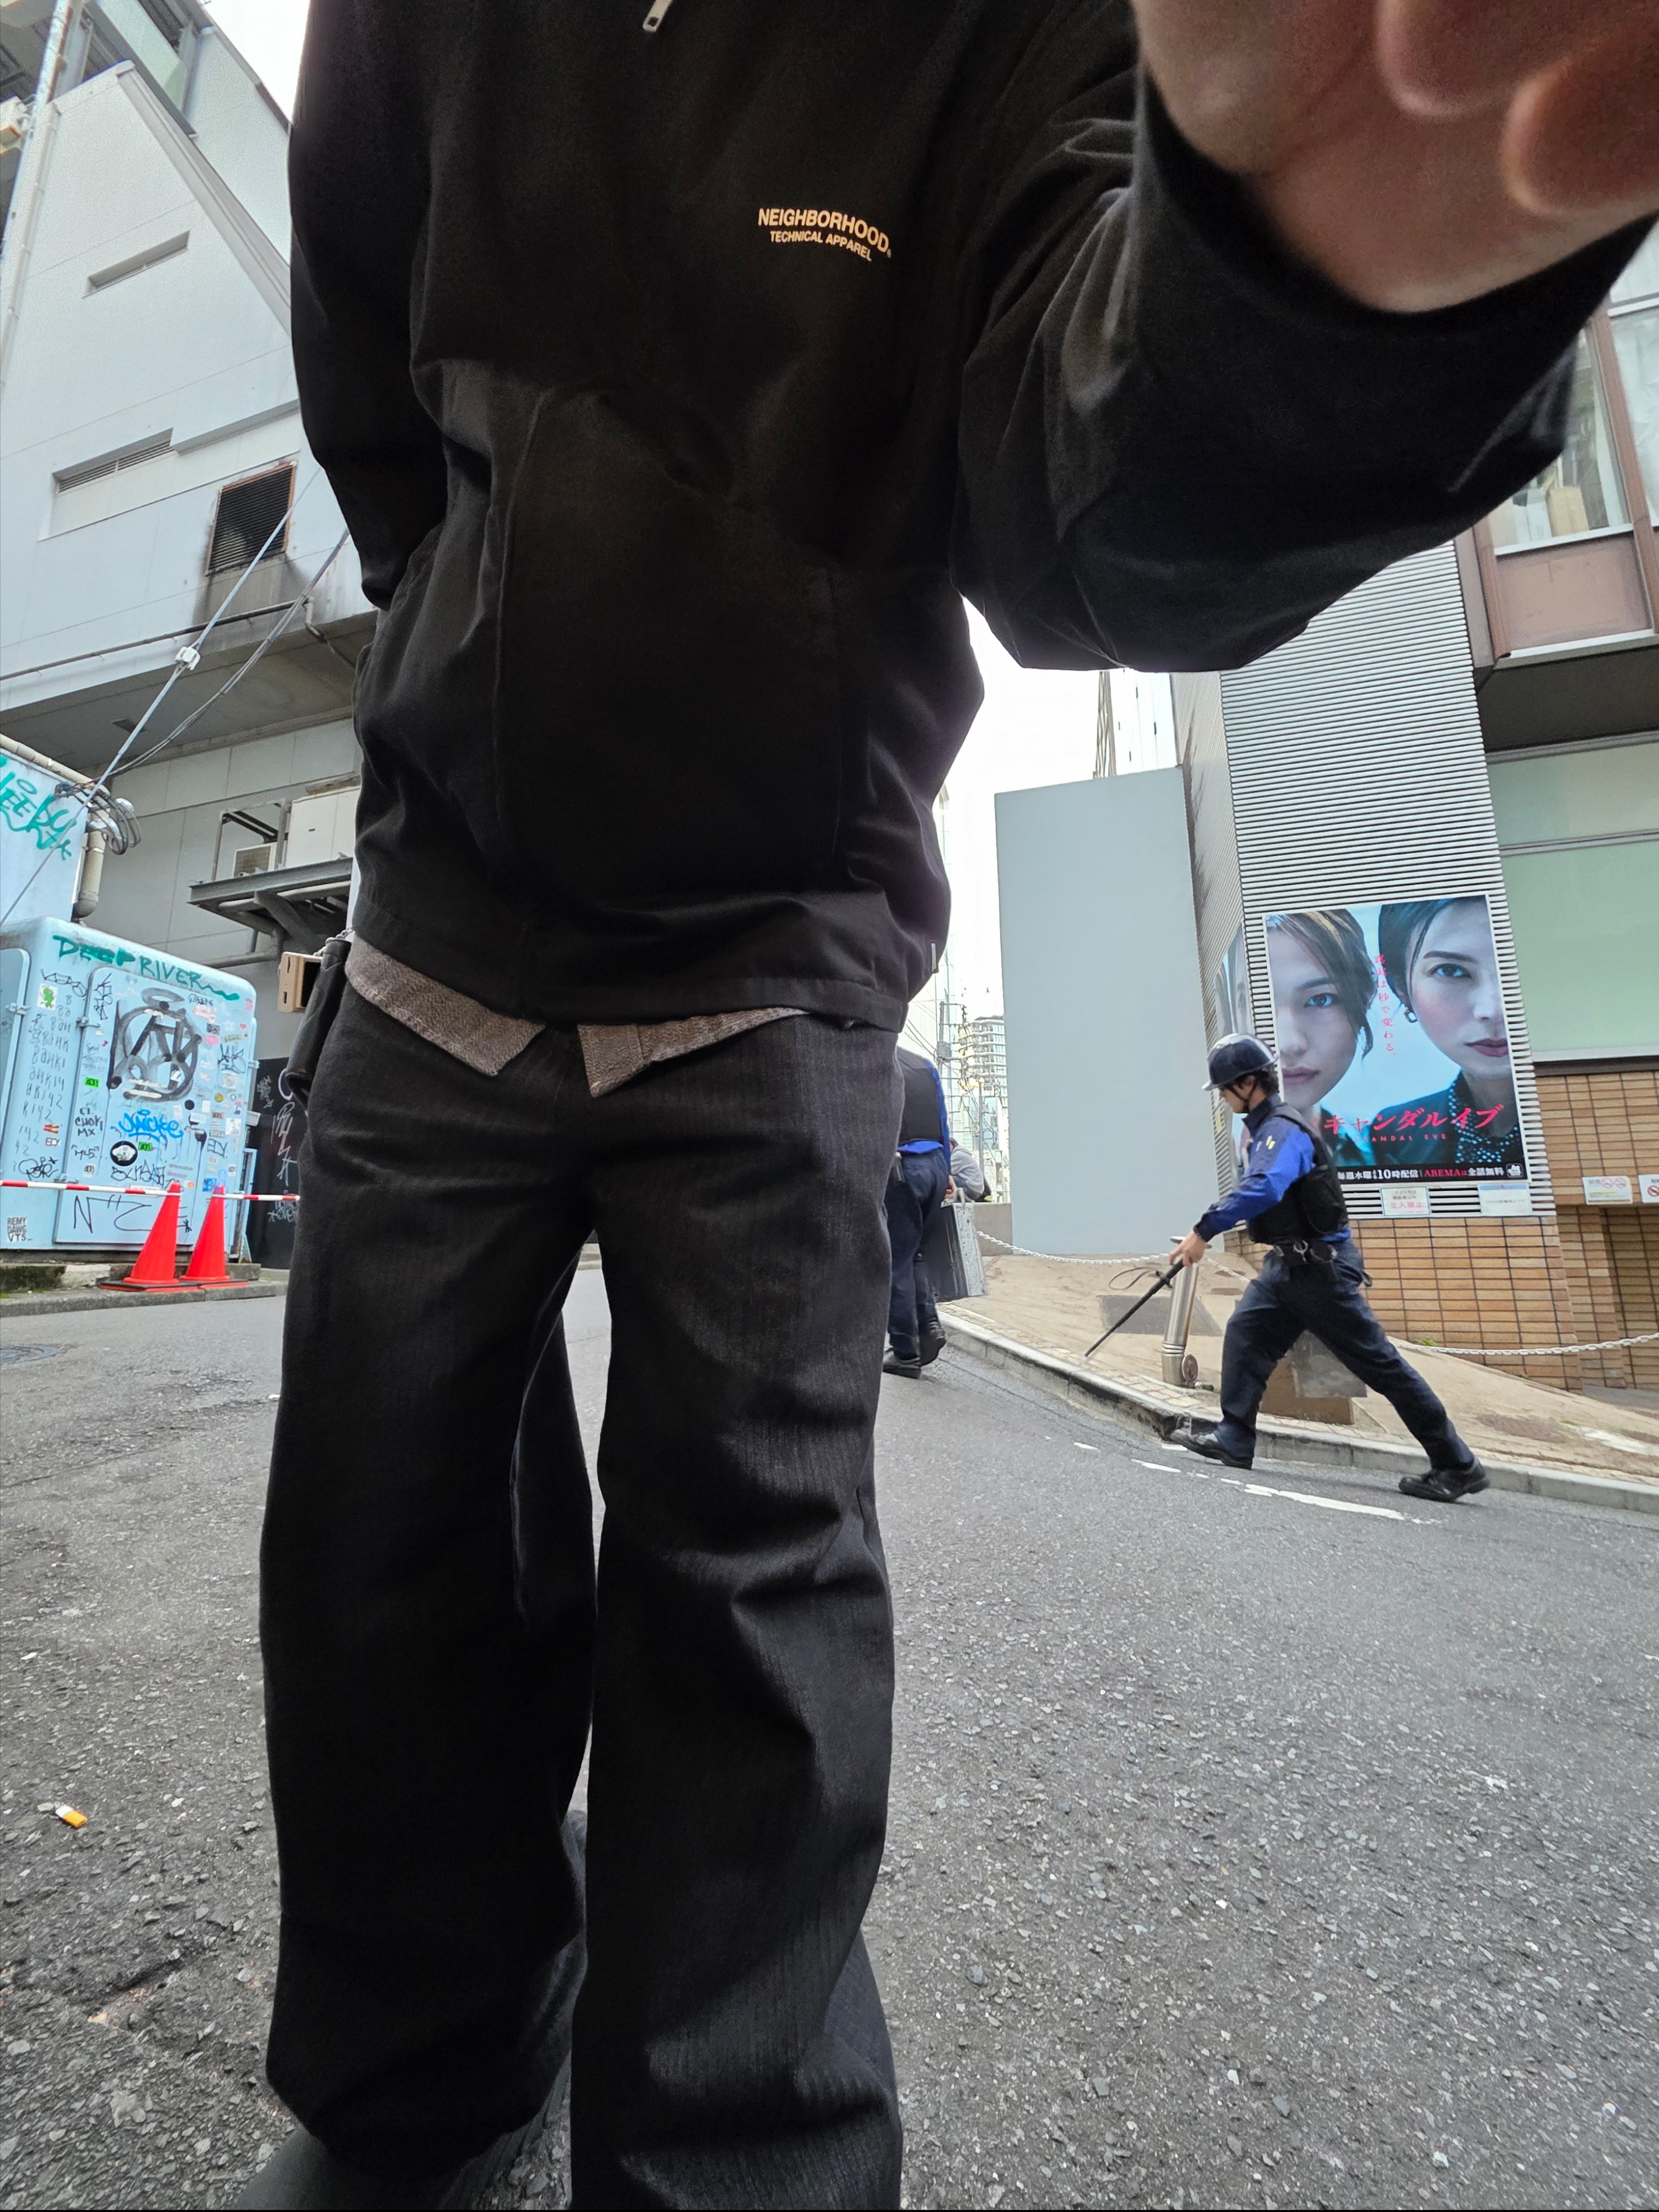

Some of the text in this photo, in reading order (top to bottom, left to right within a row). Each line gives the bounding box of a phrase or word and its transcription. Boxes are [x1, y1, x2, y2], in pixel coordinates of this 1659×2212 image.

[758, 208, 890, 253] NEIGHBORHOOD
[770, 231, 872, 262] TECHNICAL APPAREL
[139, 956, 213, 993] RIVER
